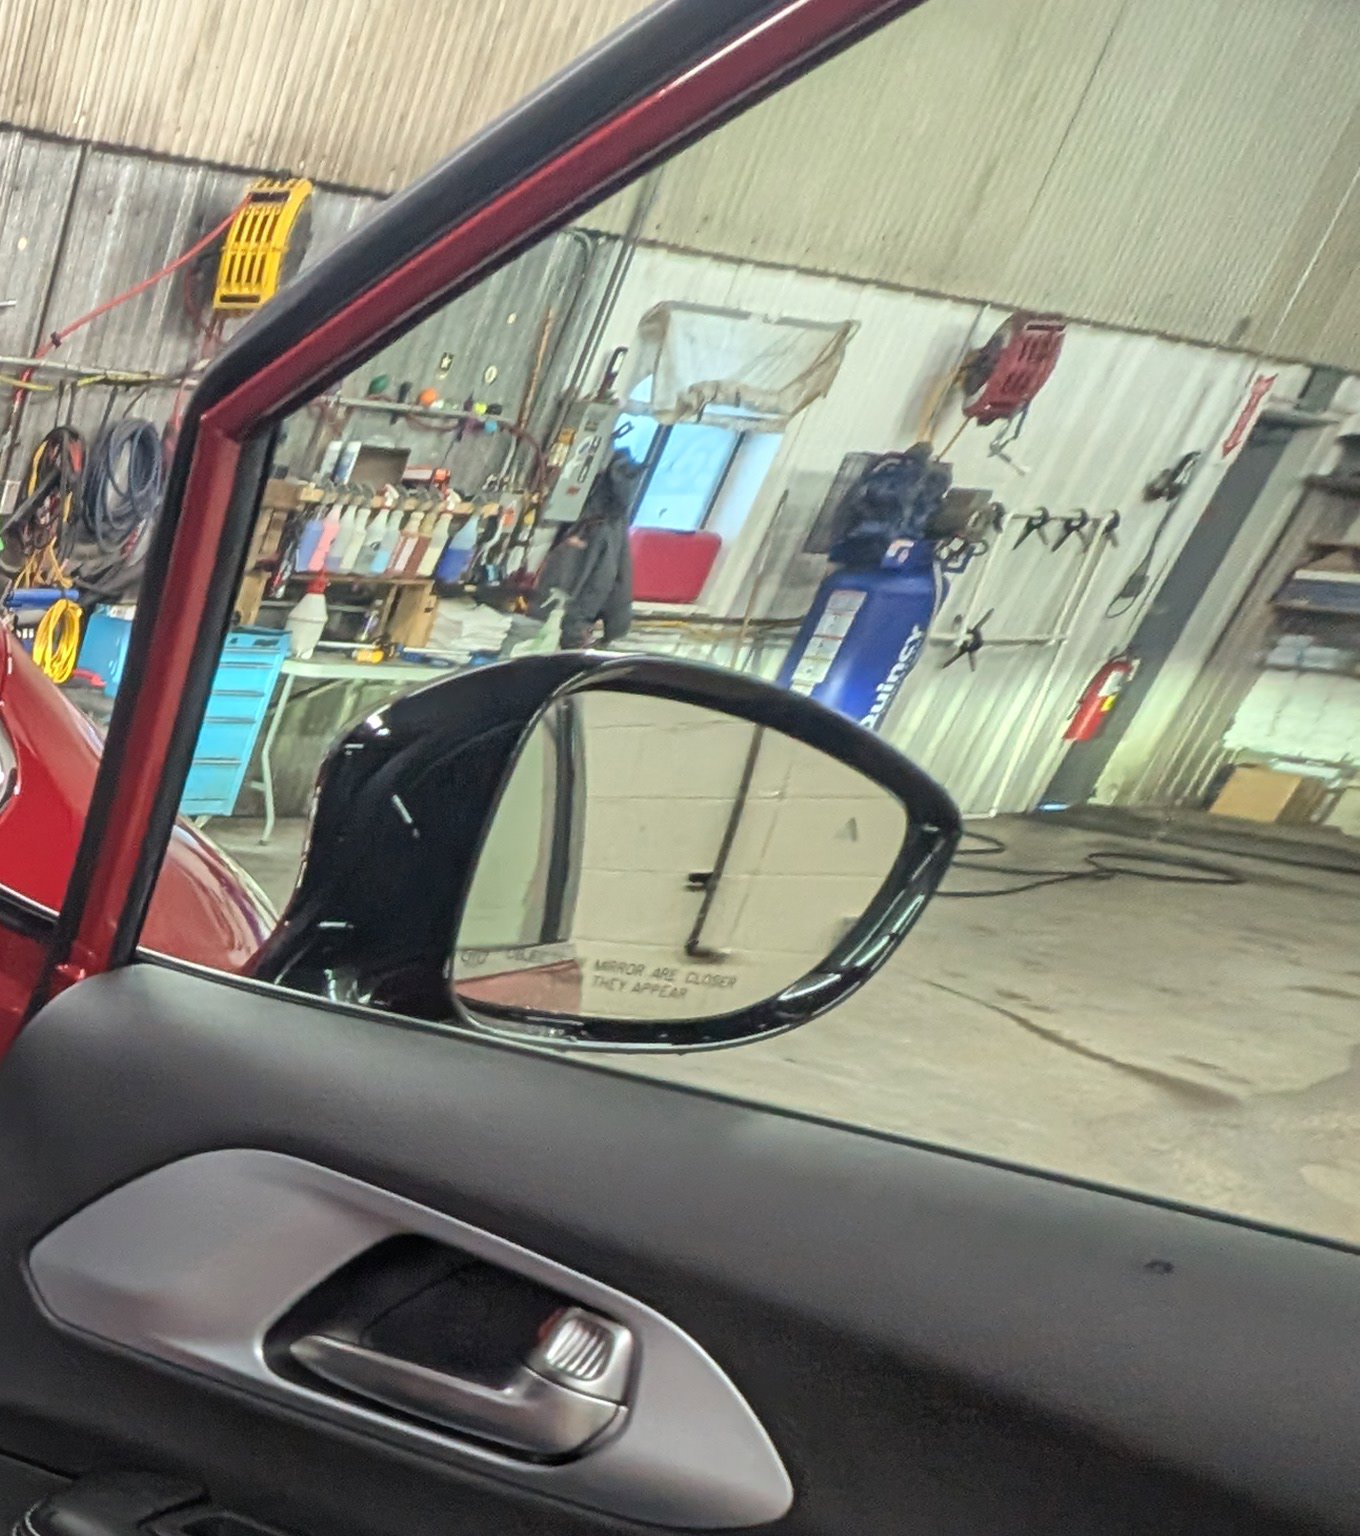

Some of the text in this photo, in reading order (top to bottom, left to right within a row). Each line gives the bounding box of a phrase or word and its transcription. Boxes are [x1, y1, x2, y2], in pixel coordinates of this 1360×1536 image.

[594, 958, 737, 988] MIRROR ARE CLOSER
[592, 975, 688, 999] THEY APPEAR
